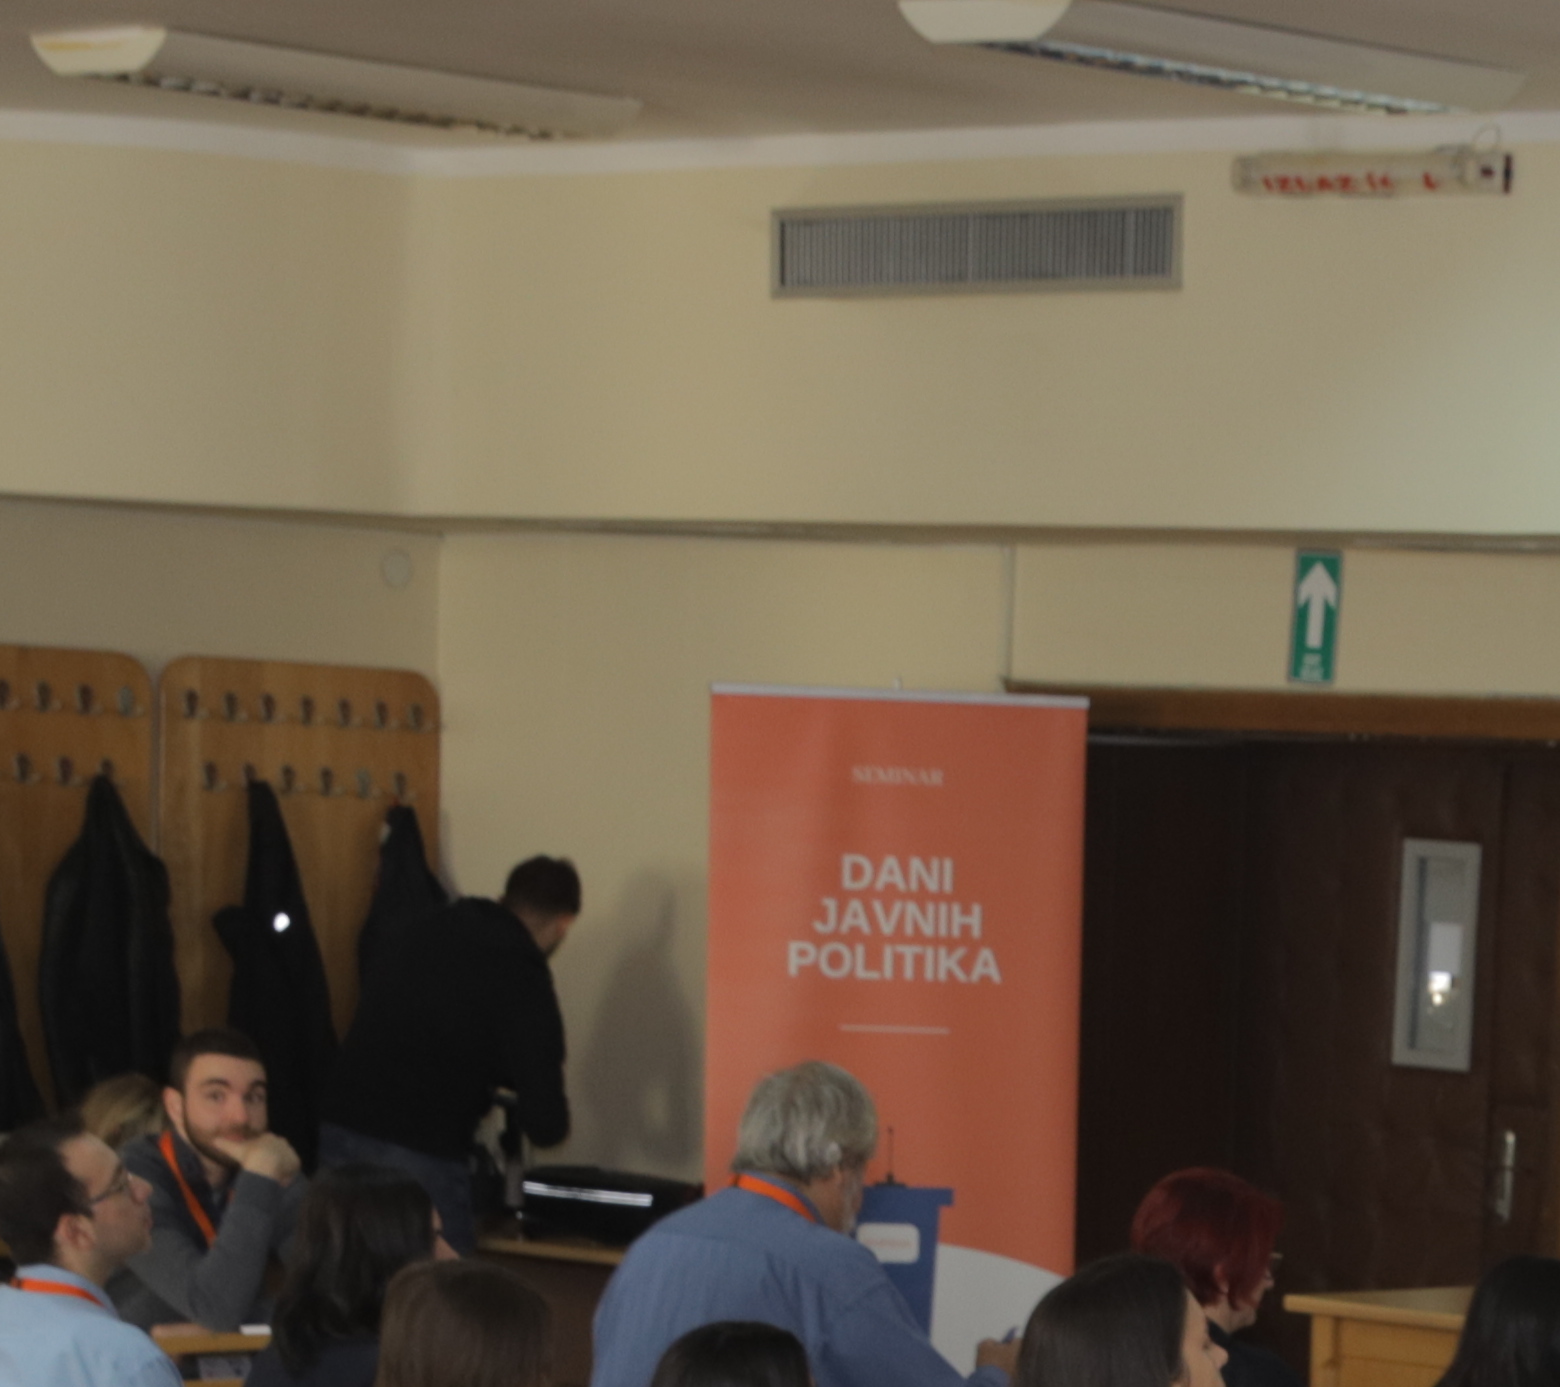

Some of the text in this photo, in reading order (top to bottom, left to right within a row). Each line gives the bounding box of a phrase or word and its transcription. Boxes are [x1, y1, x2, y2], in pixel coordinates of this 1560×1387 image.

[841, 853, 954, 893] DANI
[812, 898, 982, 939] JAVNIH
[787, 940, 1002, 984] POLITIKA
